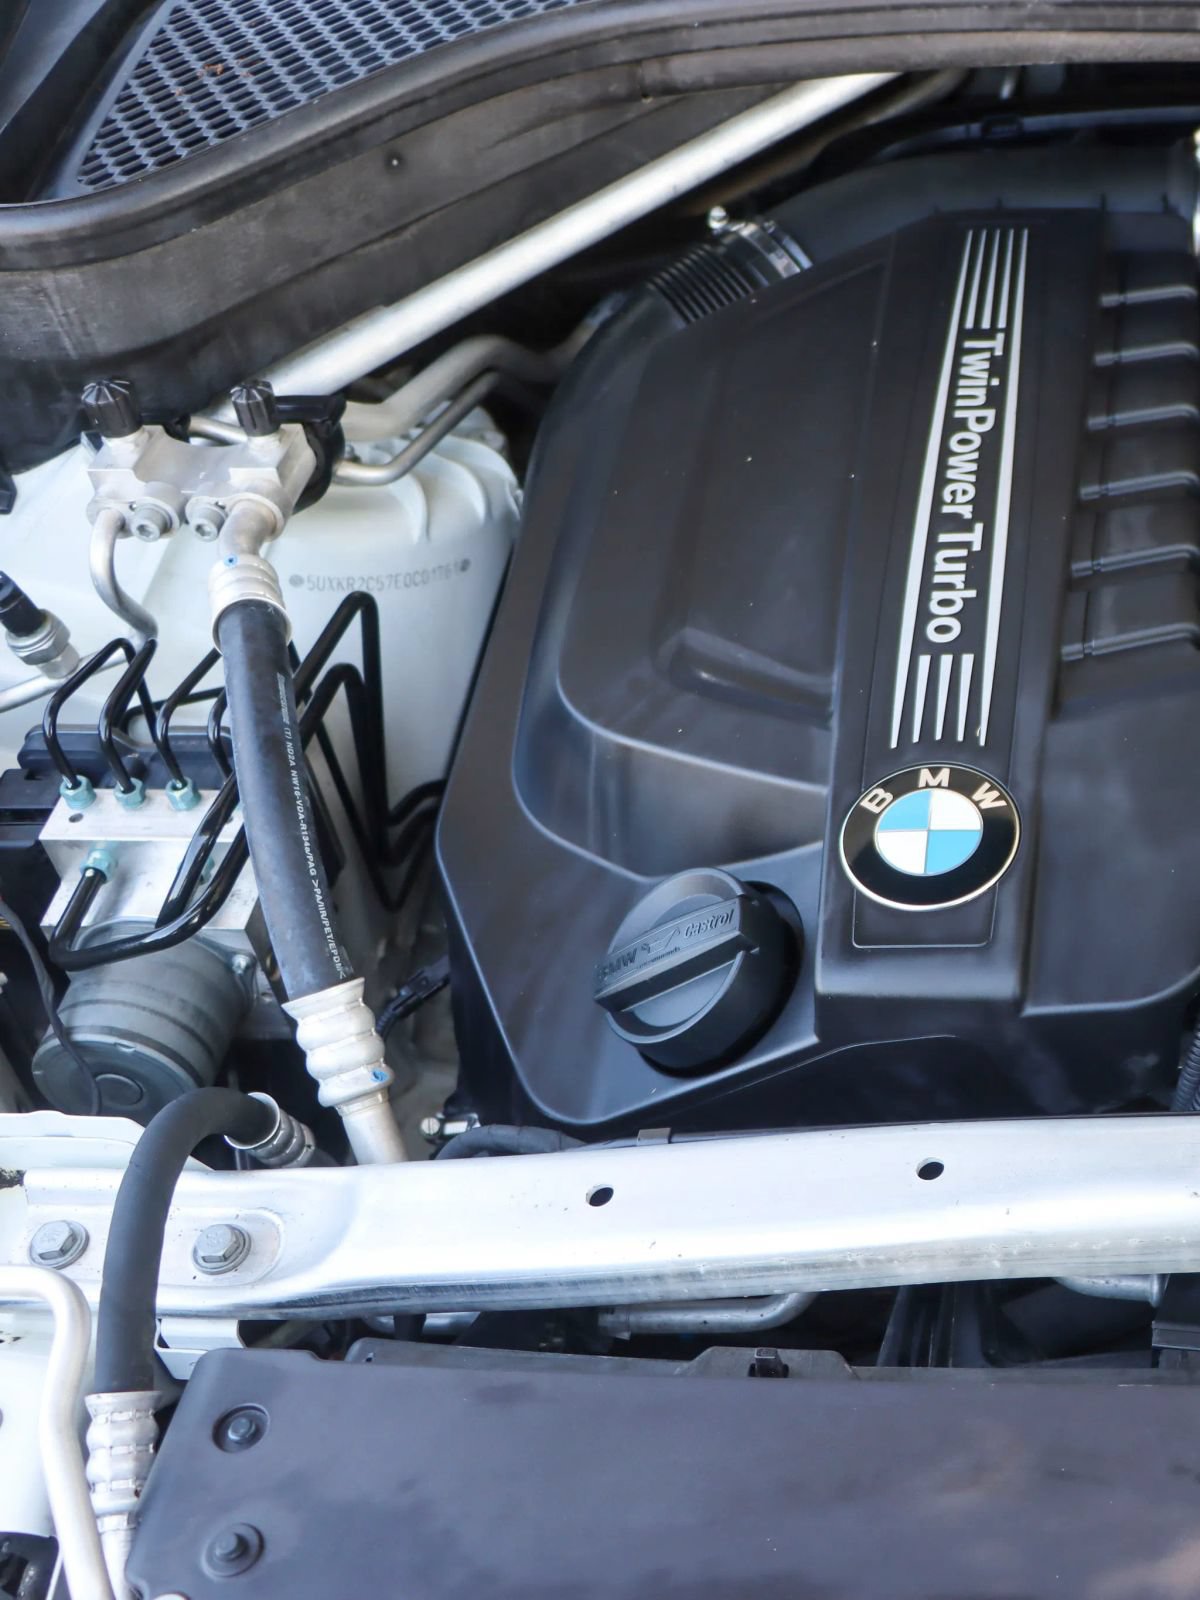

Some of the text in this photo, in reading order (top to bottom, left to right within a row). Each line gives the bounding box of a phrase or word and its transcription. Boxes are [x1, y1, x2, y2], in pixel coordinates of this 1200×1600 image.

[925, 331, 1004, 644] TwinPower Turbo
[860, 768, 1008, 814] BMW
[684, 908, 735, 938] Castrol
